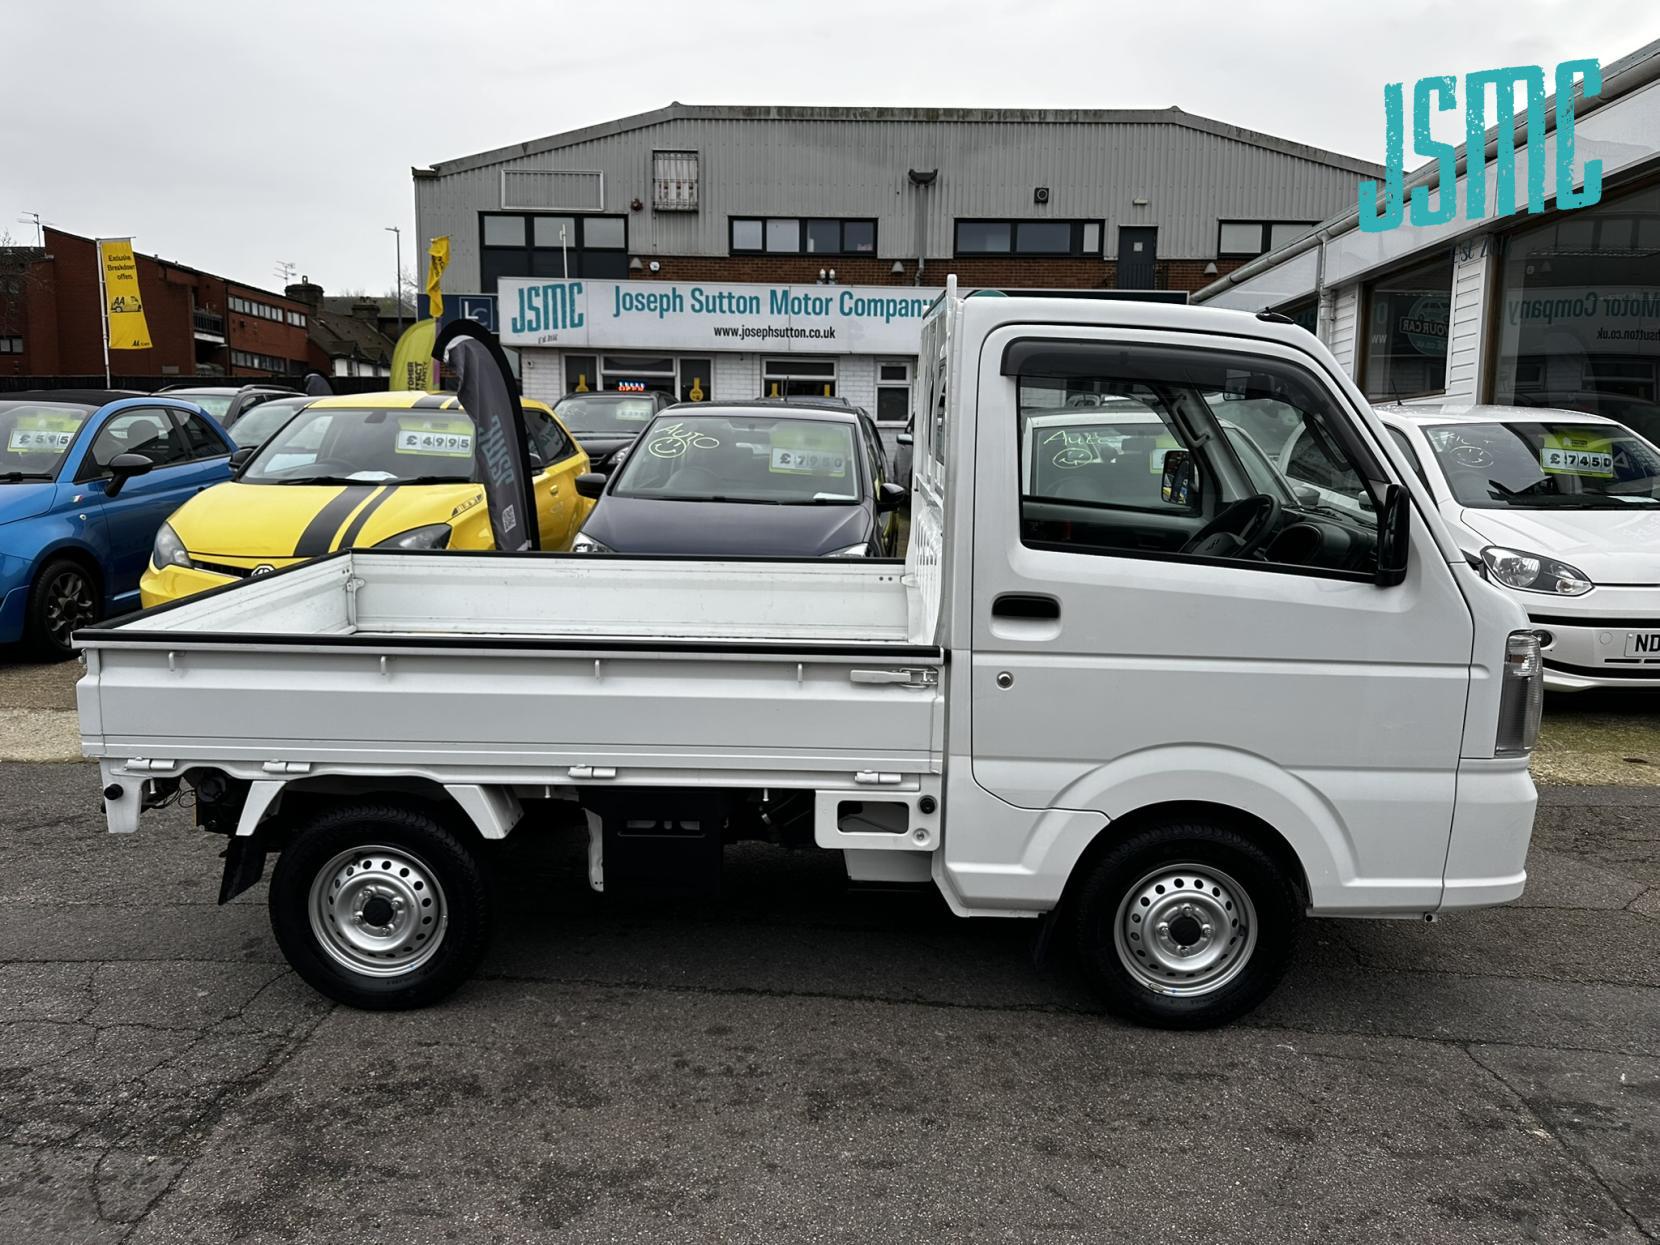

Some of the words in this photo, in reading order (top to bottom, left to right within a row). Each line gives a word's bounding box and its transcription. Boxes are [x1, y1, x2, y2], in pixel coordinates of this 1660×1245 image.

[512, 282, 584, 333] JSMC
[613, 286, 683, 318] Joseph
[691, 287, 760, 314] Sutton
[770, 289, 833, 316] Motor
[839, 290, 934, 324] Compan
[714, 325, 836, 341] www.josephsutton.co.uk
[1634, 633, 1660, 652] ND
